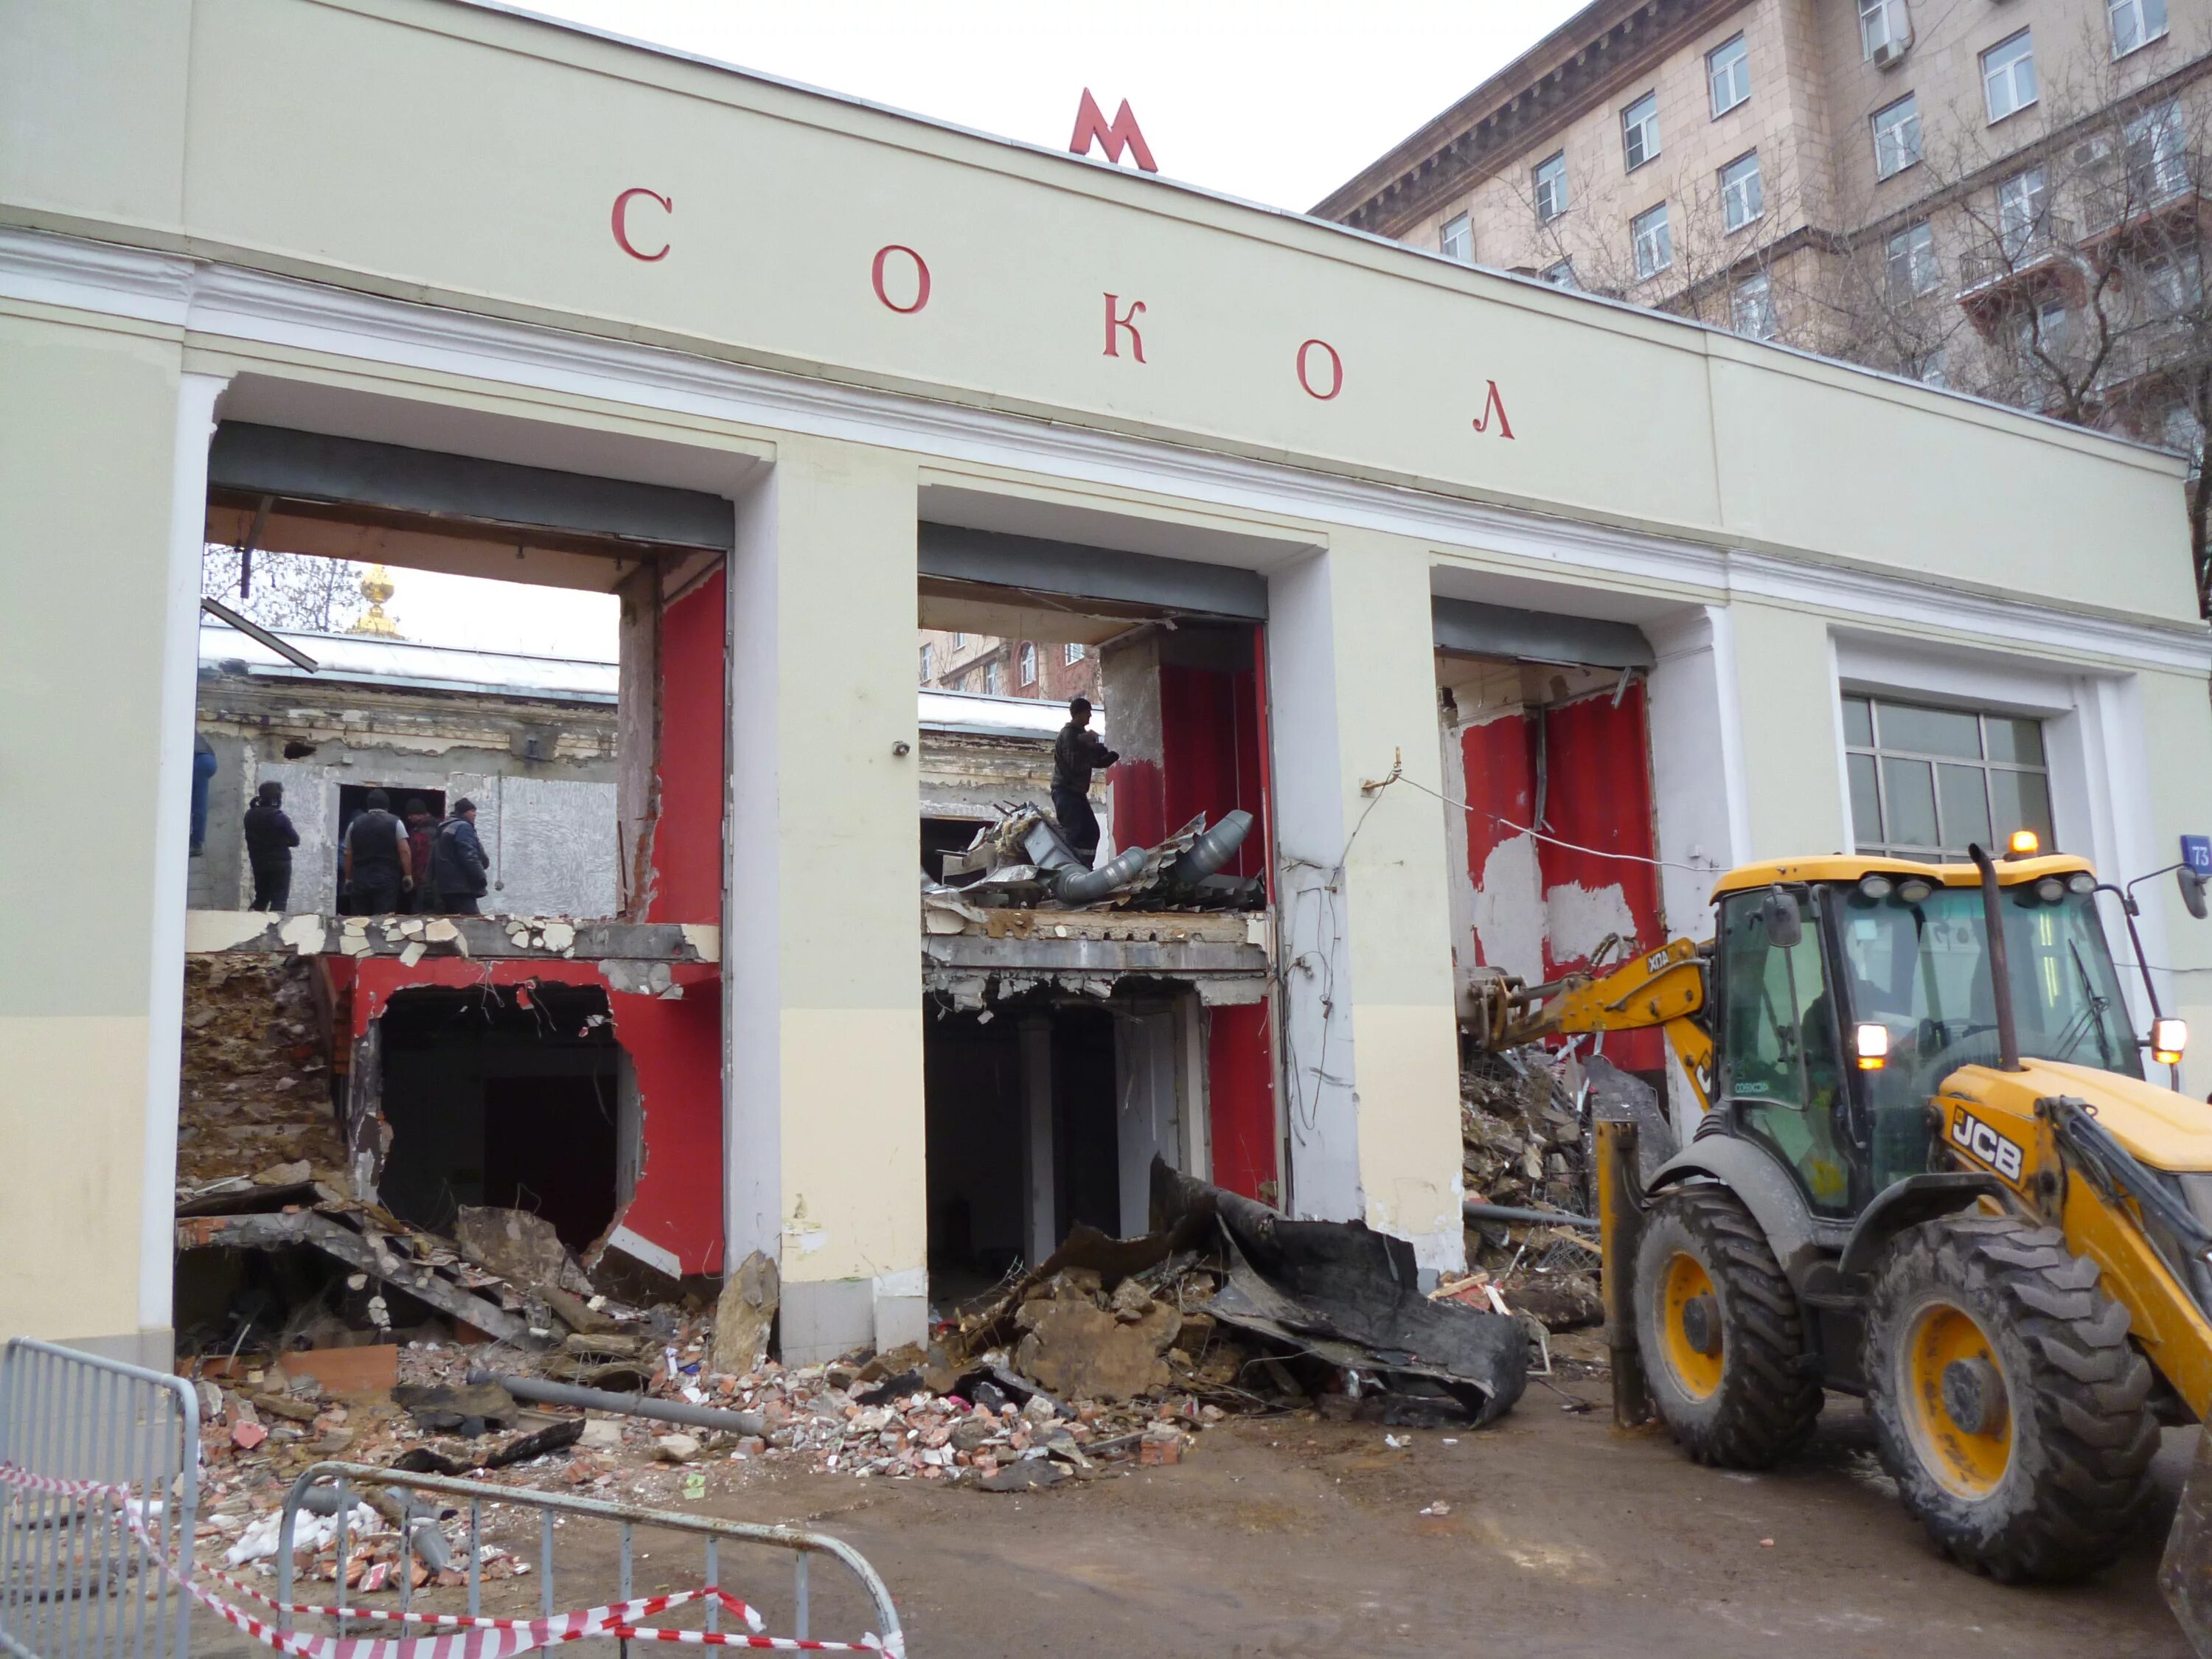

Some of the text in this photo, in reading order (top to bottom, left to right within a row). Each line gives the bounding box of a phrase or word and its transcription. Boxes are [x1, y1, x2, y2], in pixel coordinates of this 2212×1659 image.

[1069, 86, 1158, 173] М
[611, 187, 1515, 439] СОКОЛ
[2191, 846, 2209, 866] 73
[1952, 1114, 2022, 1180] JCB
